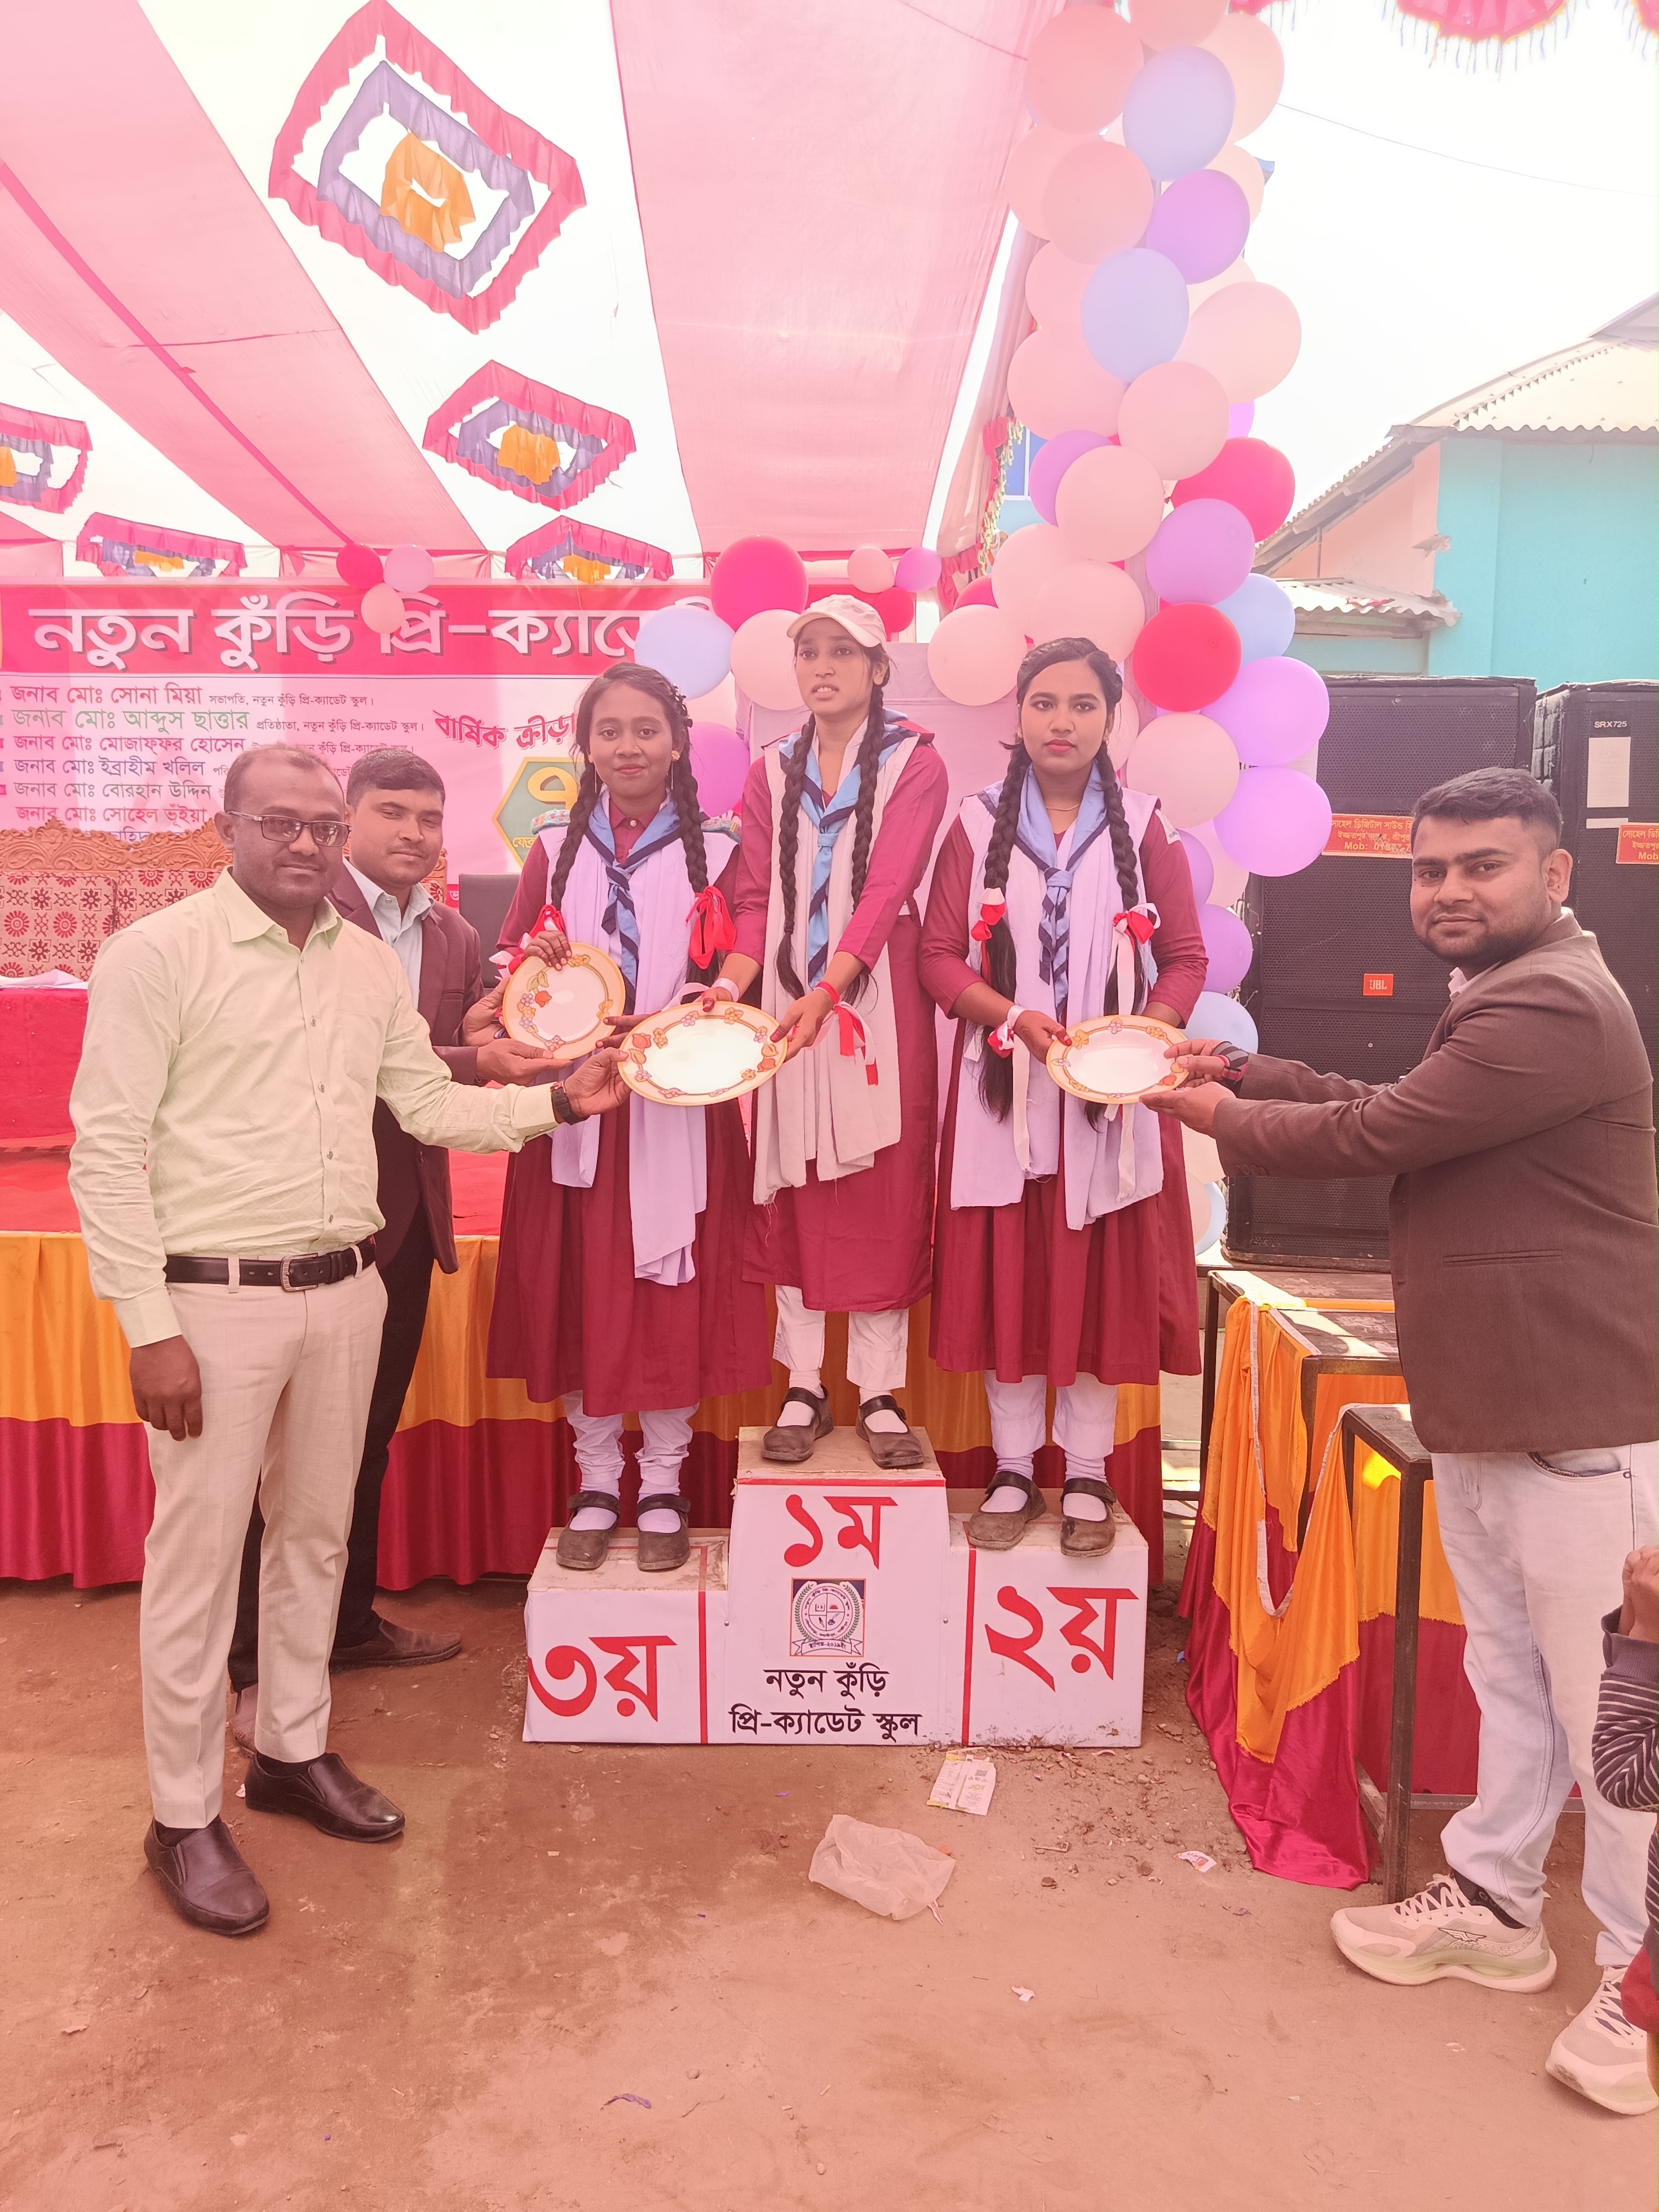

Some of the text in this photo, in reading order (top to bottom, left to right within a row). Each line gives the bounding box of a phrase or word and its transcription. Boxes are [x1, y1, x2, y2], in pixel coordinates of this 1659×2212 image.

[29, 608, 194, 671] নতুন
[211, 593, 357, 671] কুঁড়ি
[9, 685, 59, 703] জনাব
[67, 685, 103, 704] মোঃ
[111, 686, 159, 705] সোনা
[164, 682, 204, 705] মিয়া
[209, 693, 248, 706] সভাপতি,
[253, 696, 274, 707] নতুন
[277, 693, 295, 707] কুঁড়ি
[299, 693, 346, 706] প্রি-ক্যাডেট
[11, 707, 66, 728] জনাব
[75, 708, 115, 729] মোঃ
[122, 709, 186, 734] আব্দুস
[191, 709, 250, 732] ছাত্তার
[303, 722, 325, 733] নতুন
[328, 719, 346, 733] কুঁড়ি
[350, 719, 397, 732] প্রি-ক্যাডেট
[433, 709, 508, 749] বার্ষিক
[13, 734, 56, 751] জনাব
[62, 735, 92, 751] মোঃ
[191, 737, 246, 754] হোসেন
[14, 758, 56, 774] জনাব
[62, 759, 95, 774] মোঃ
[98, 755, 156, 777] ইব্রাহীম
[163, 756, 206, 775] খলিল
[14, 781, 57, 798] জনাব
[64, 782, 95, 798] মোঃ
[103, 782, 163, 799] বোরহান
[168, 779, 212, 799] উদ্দিন
[15, 805, 58, 821] জনাব
[65, 806, 96, 822] মোঃ
[103, 806, 159, 824] সোহেল
[1344, 842, 1368, 851] Mob:
[1623, 830, 1646, 838] সোহেল
[1369, 979, 1387, 990] JBL
[783, 1494, 898, 1569] ১ম
[984, 1585, 1139, 1693] ২য়
[528, 1635, 676, 1722] ৩য়
[763, 1662, 890, 1700] নতুন কুঁড়ি
[728, 1703, 923, 1743] প্রি-ক্যাডেট স্কুল
